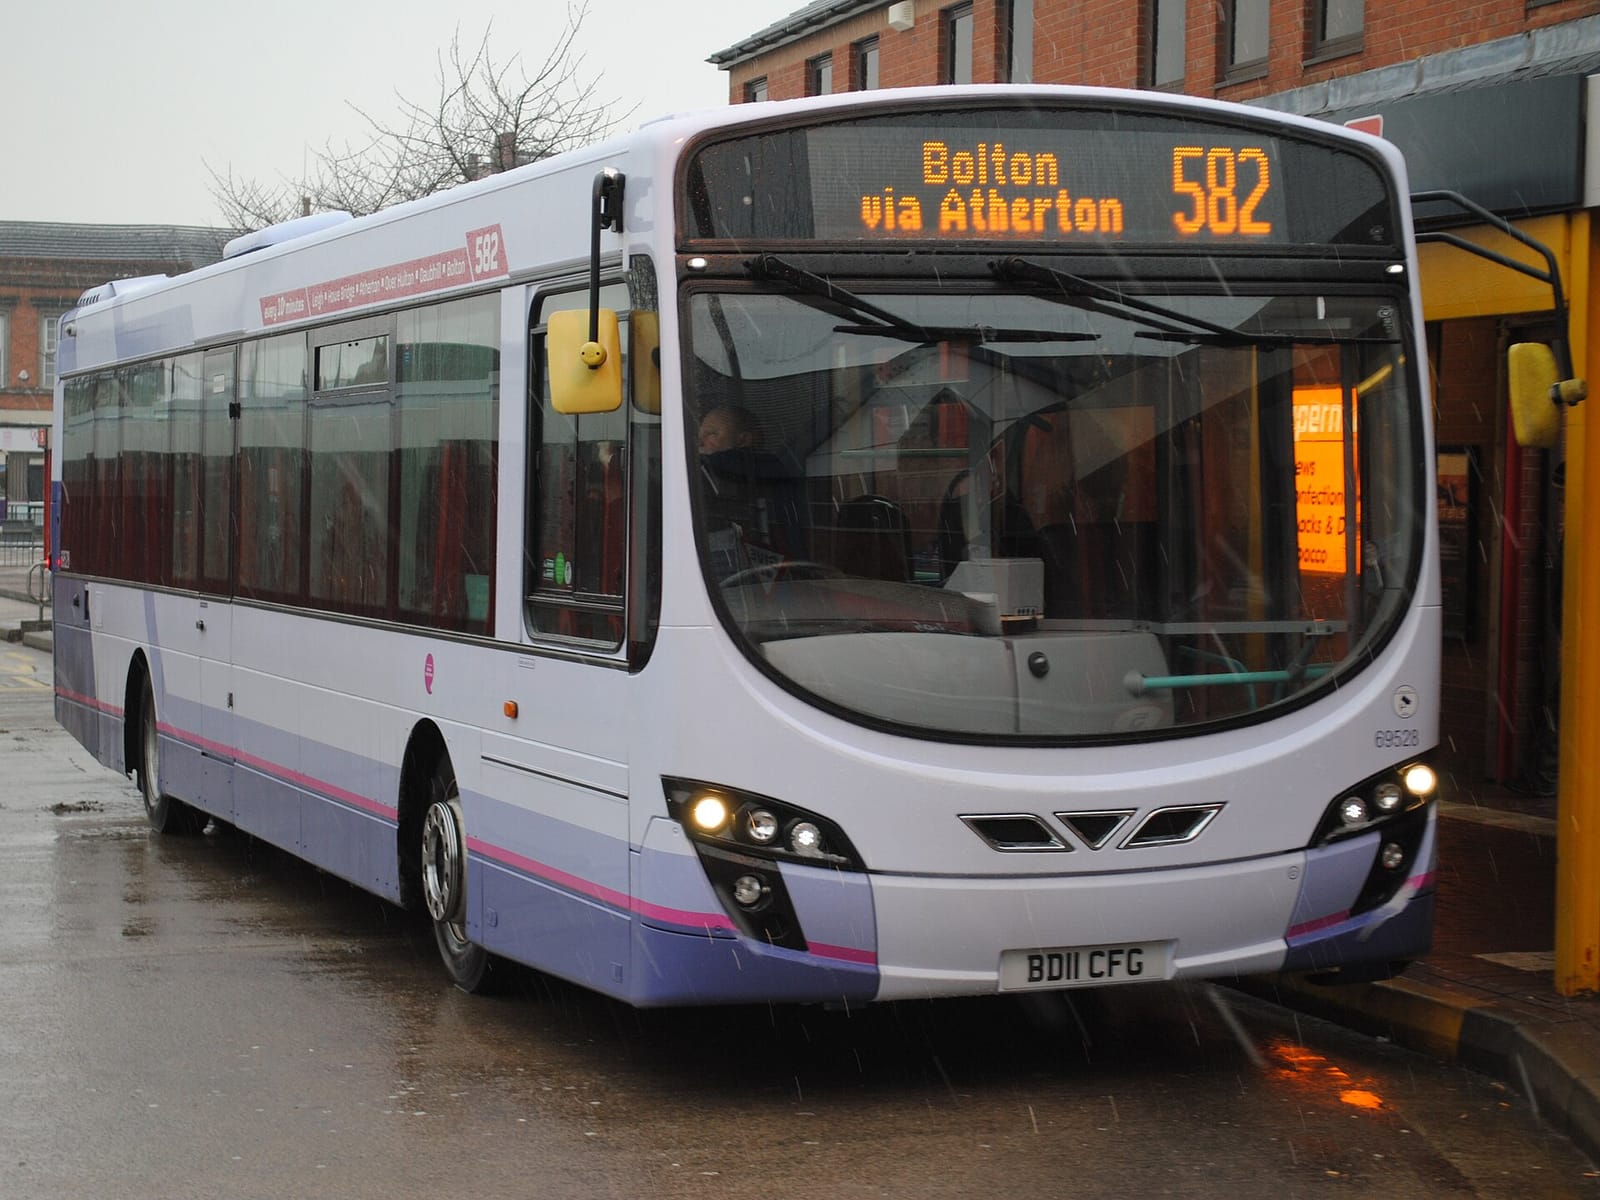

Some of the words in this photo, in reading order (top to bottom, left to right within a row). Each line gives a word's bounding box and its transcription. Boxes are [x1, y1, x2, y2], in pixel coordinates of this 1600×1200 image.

[922, 141, 1058, 185] Bolton
[1172, 146, 1272, 235] 582
[861, 187, 923, 231] via
[938, 187, 1123, 233] Atherton
[447, 257, 466, 277] Bolton
[474, 231, 498, 274] 582
[263, 305, 278, 321] every
[277, 296, 285, 317] 10
[286, 298, 304, 314] minutes
[1295, 460, 1316, 476] ews
[1375, 729, 1419, 748] 69528
[1027, 951, 1080, 982] BD11
[1089, 948, 1144, 978] CFG
